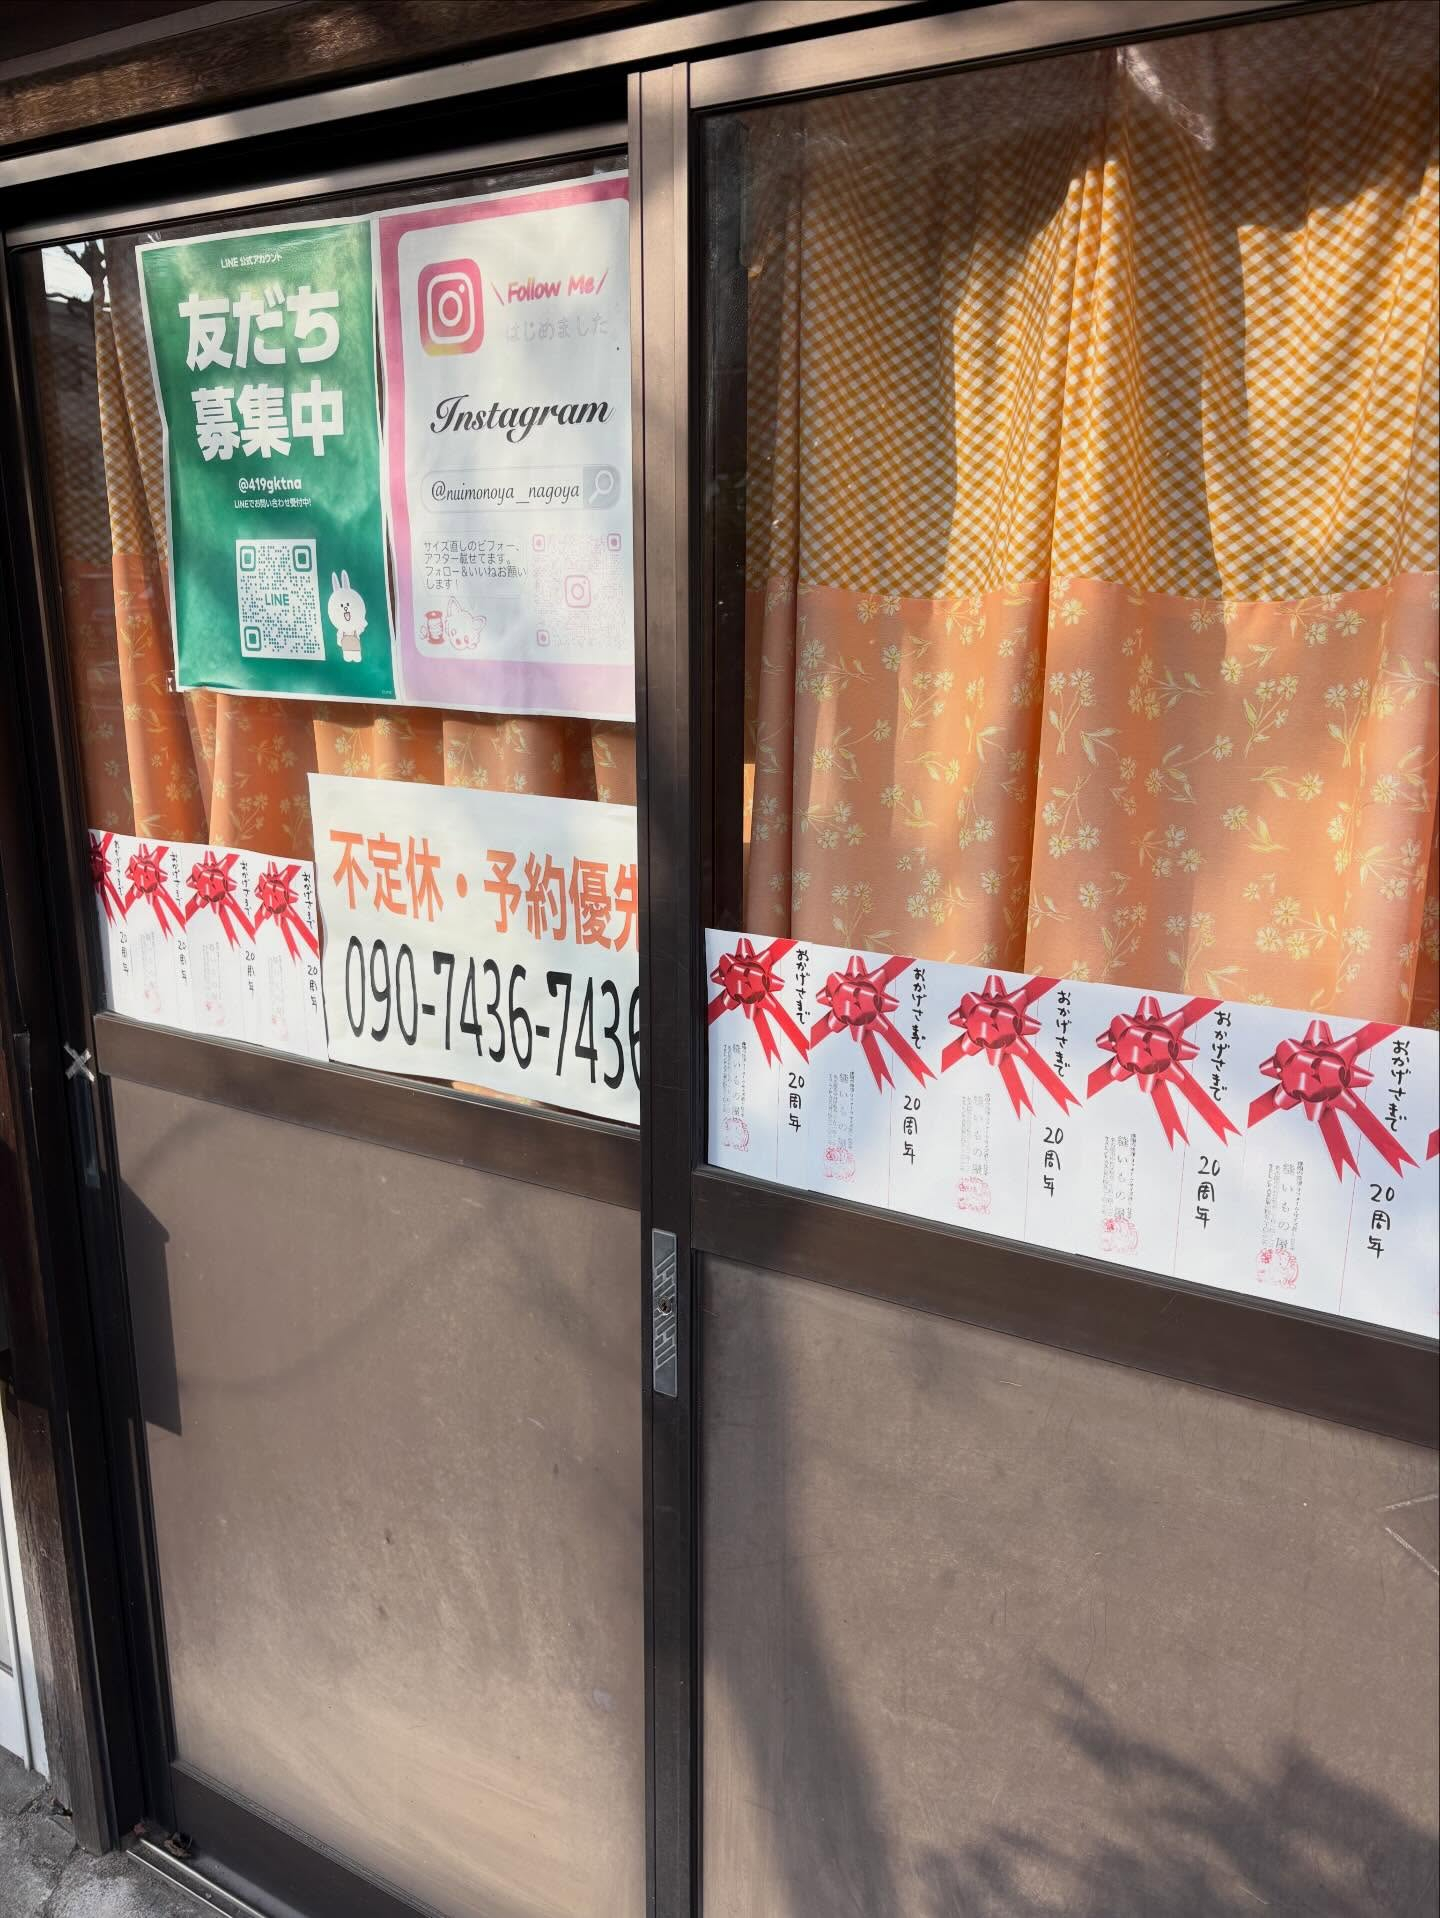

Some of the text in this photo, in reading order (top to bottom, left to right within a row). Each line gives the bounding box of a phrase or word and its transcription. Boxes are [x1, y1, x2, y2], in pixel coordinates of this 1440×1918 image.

[220, 250, 282, 268] LINE 公式アカウント
[508, 273, 594, 304] Follow Me
[178, 285, 340, 372] 友だち
[506, 312, 608, 342] はじめました
[191, 379, 344, 462] 募集中
[430, 394, 614, 444] Instagram
[238, 475, 303, 494] @419gktna
[431, 480, 580, 506] @nuimonoya_nagoya
[264, 593, 290, 606] LINE
[329, 829, 639, 952] 不定休・予約優先
[795, 949, 810, 1025] おかげさまで
[911, 968, 929, 1050] おかげさまで
[1055, 990, 1072, 1078] おかげさまで
[1209, 1011, 1232, 1101] おかげさまで
[788, 1072, 806, 1132] 20周年
[1384, 1040, 1412, 1132] おかげさまで
[903, 1095, 921, 1165] 20周年
[1043, 1127, 1064, 1197] 20周年
[1195, 1155, 1221, 1229] 20周年
[1367, 1183, 1395, 1258] 20周年
